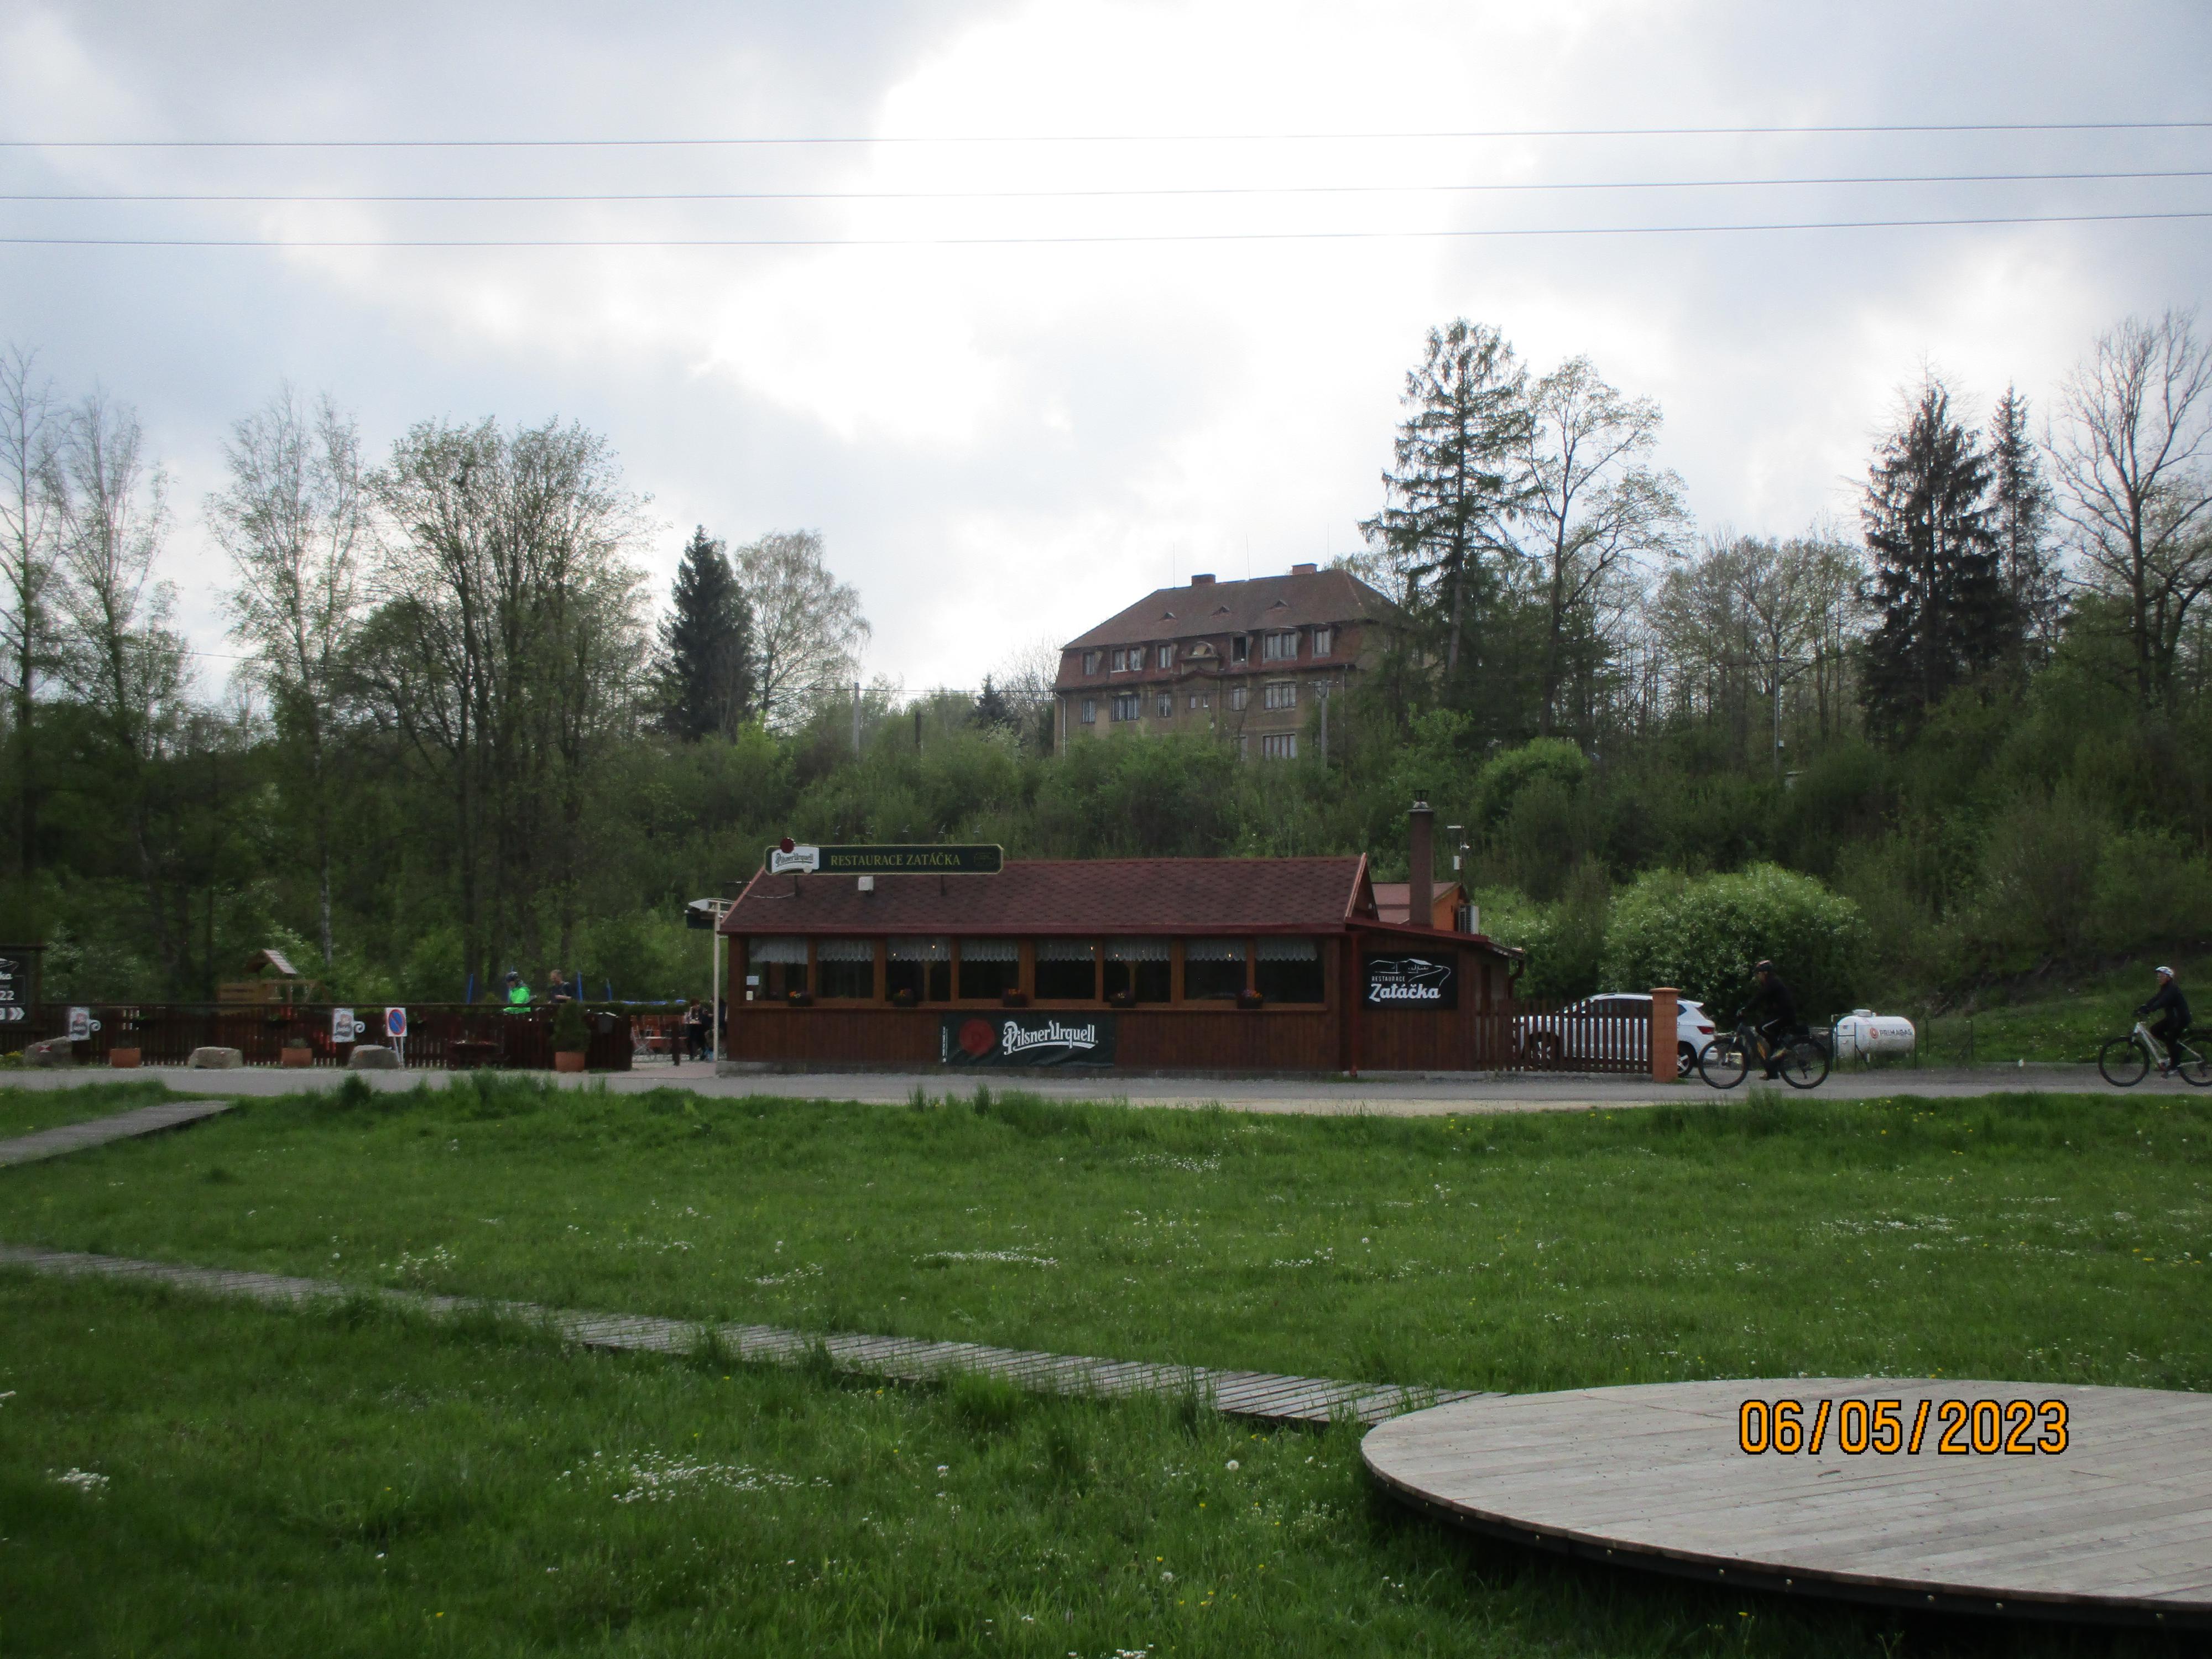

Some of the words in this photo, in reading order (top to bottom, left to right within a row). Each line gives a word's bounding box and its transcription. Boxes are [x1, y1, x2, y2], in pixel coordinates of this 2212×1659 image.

[831, 854, 903, 866] RESTAURACE
[906, 852, 961, 866] ZATÁČKA
[1369, 983, 1441, 1002] Zatáčka
[1002, 1021, 1050, 1055] Pilsner
[1048, 1020, 1095, 1049] Urquell
